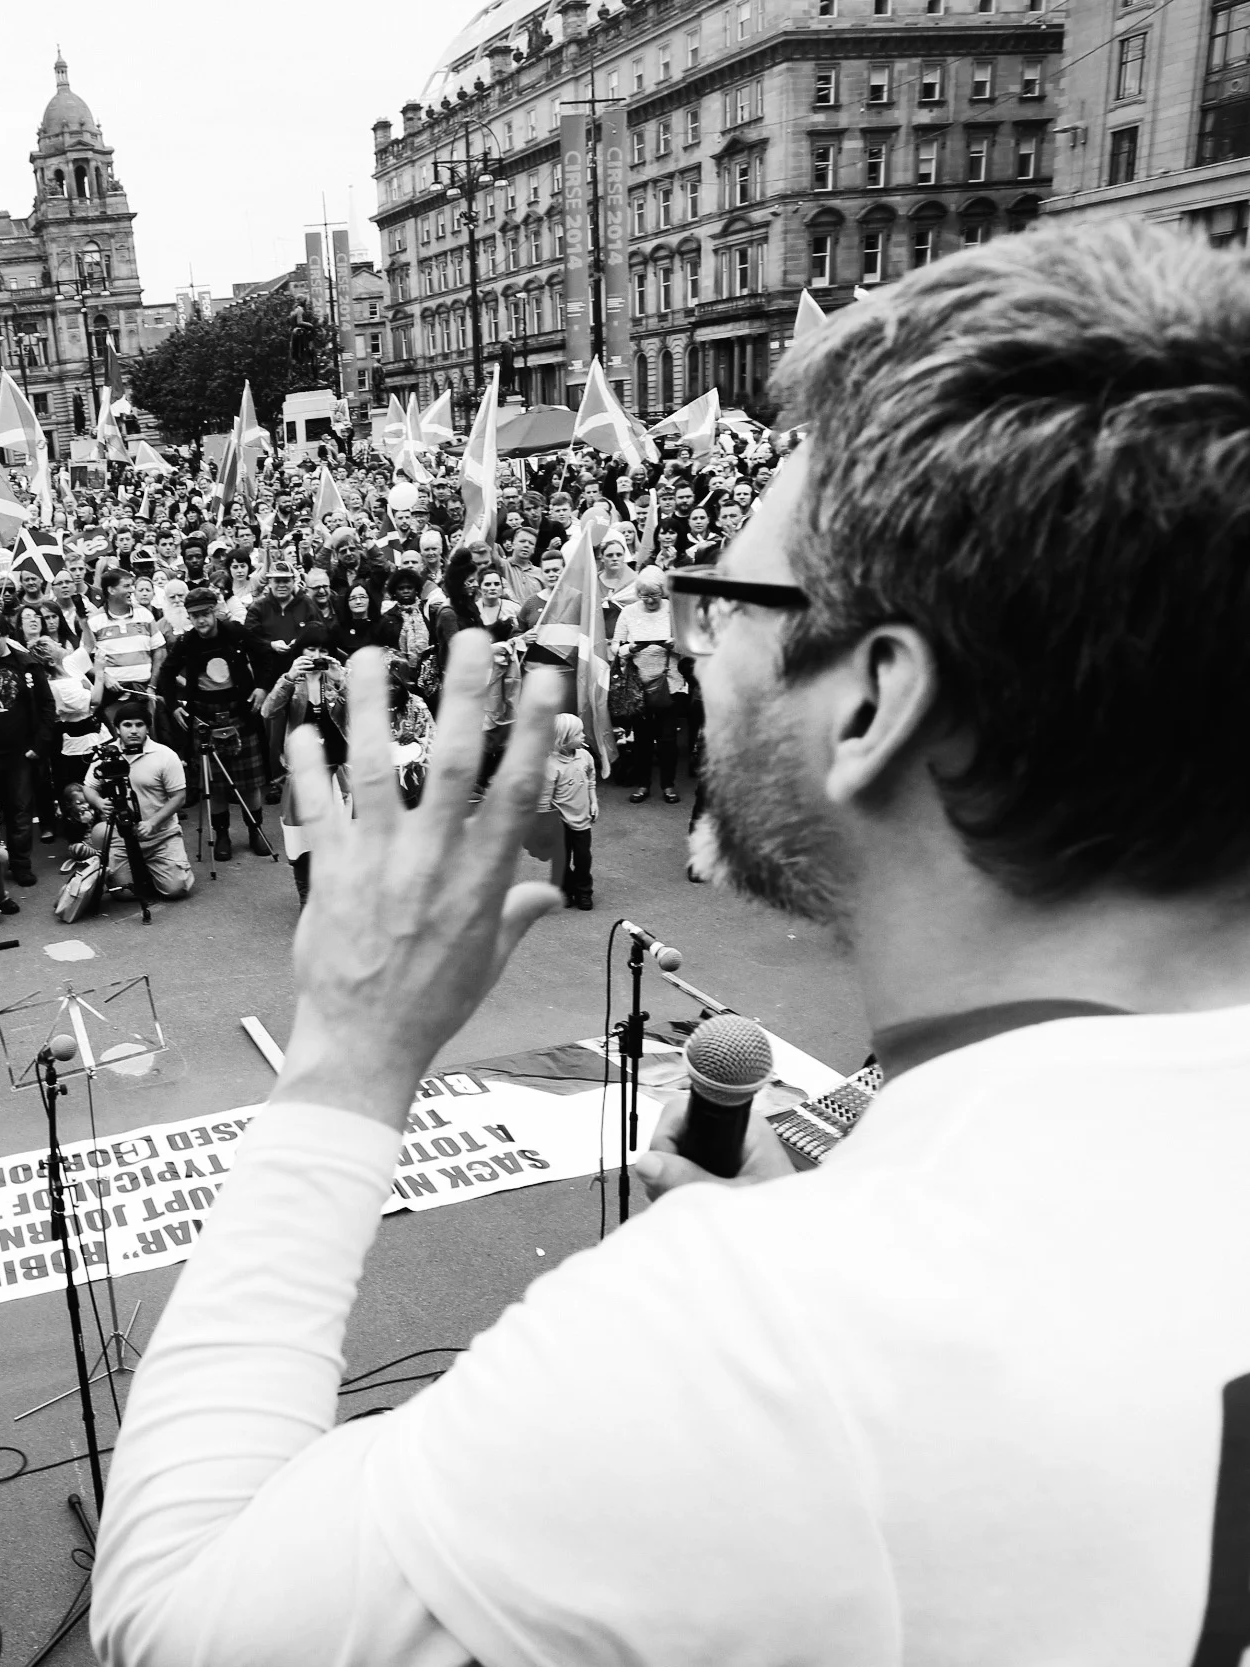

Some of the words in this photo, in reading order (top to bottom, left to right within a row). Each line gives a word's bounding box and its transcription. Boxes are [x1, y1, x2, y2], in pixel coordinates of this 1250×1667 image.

[563, 149, 583, 211] CIRSE
[606, 146, 623, 206] CIRSE
[565, 214, 583, 271] 2014
[607, 210, 624, 266] 2014
[309, 255, 323, 294] CIRSE
[336, 252, 350, 292] CIRSE
[338, 295, 352, 331] 2014
[65, 535, 109, 556] Yes
[481, 1124, 516, 1144] A
[67, 1153, 231, 1203] TYPICAL
[390, 1172, 439, 1200] NI
[435, 1149, 551, 1189] SACK
[12, 1188, 53, 1218] OF
[142, 1182, 225, 1222] UPT
